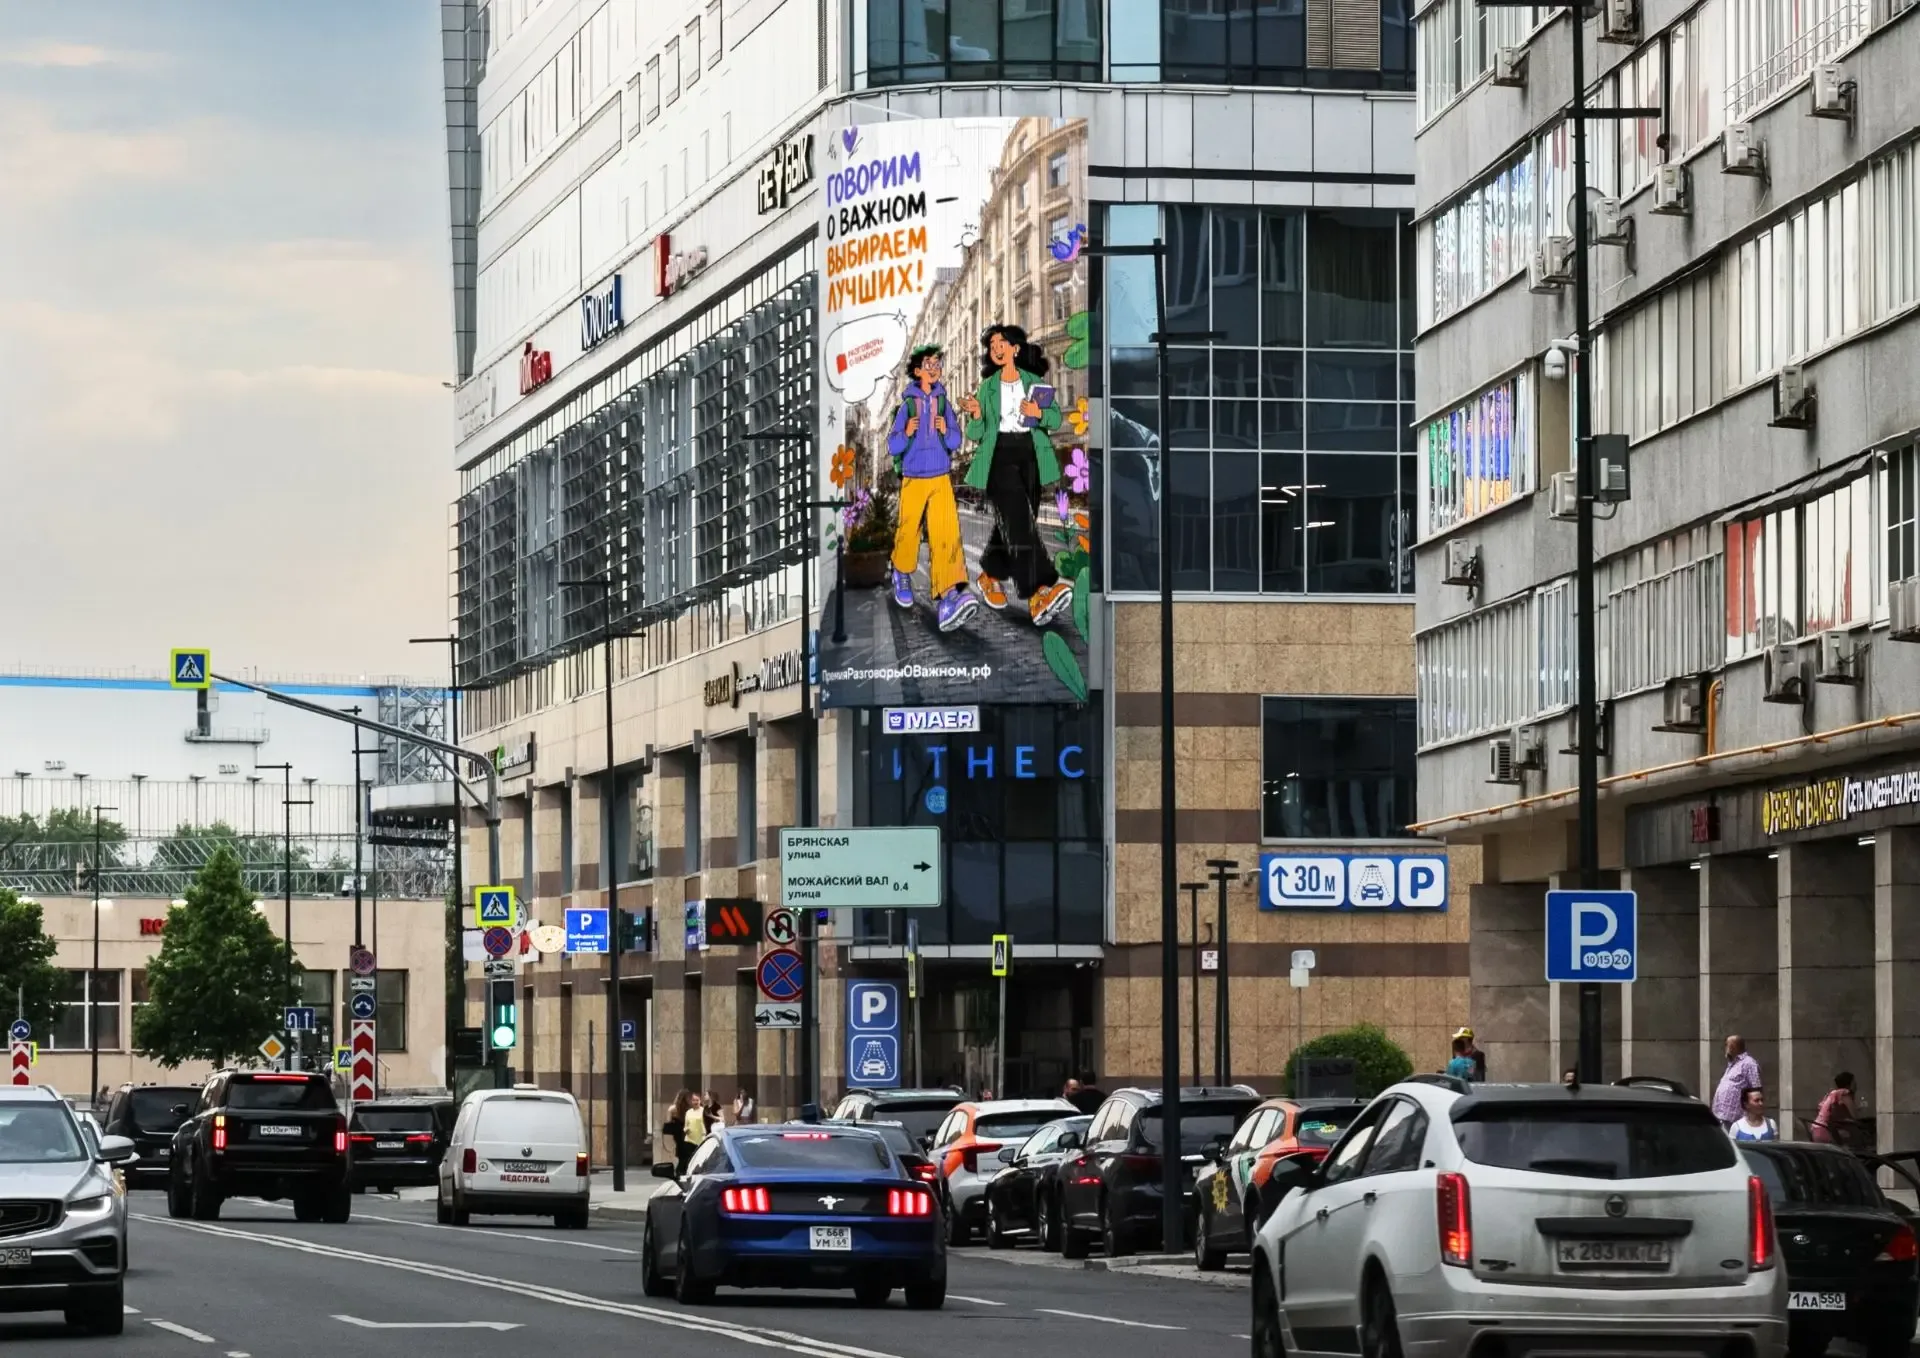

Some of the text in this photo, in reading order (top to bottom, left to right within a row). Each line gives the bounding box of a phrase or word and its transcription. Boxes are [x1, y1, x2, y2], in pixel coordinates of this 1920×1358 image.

[826, 150, 921, 208] ГОВОРИМ
[826, 217, 836, 241] О
[839, 190, 927, 236] ВАЖНОМ
[826, 225, 928, 278] ВЫБИРАЕМ
[826, 259, 924, 314] ЛУЧШИХ!
[580, 274, 621, 350] NOVOTEL
[821, 663, 992, 683] ПремияРазговорыОВажном.рф
[906, 710, 975, 730] MAER
[1771, 787, 1805, 836] FRENCH
[1806, 779, 1844, 829] BAKERY
[1848, 781, 1864, 813] СЕТЬ
[787, 837, 850, 847] БРЯНСКАЯ
[787, 850, 821, 861] улица
[788, 875, 862, 887] МОЖАЙСКИЙ
[865, 876, 889, 886] ВАЛ
[1294, 865, 1321, 893] 30
[1410, 866, 1435, 900] P
[788, 890, 821, 900] улица
[580, 913, 593, 931] P
[1571, 902, 1618, 971] P
[1585, 953, 1630, 966] 10 15 20
[862, 991, 888, 1024] P
[620, 1022, 632, 1039] P
[500, 1174, 550, 1184] МЕДСЛУЖБА
[1820, 1292, 1842, 1305] 550
